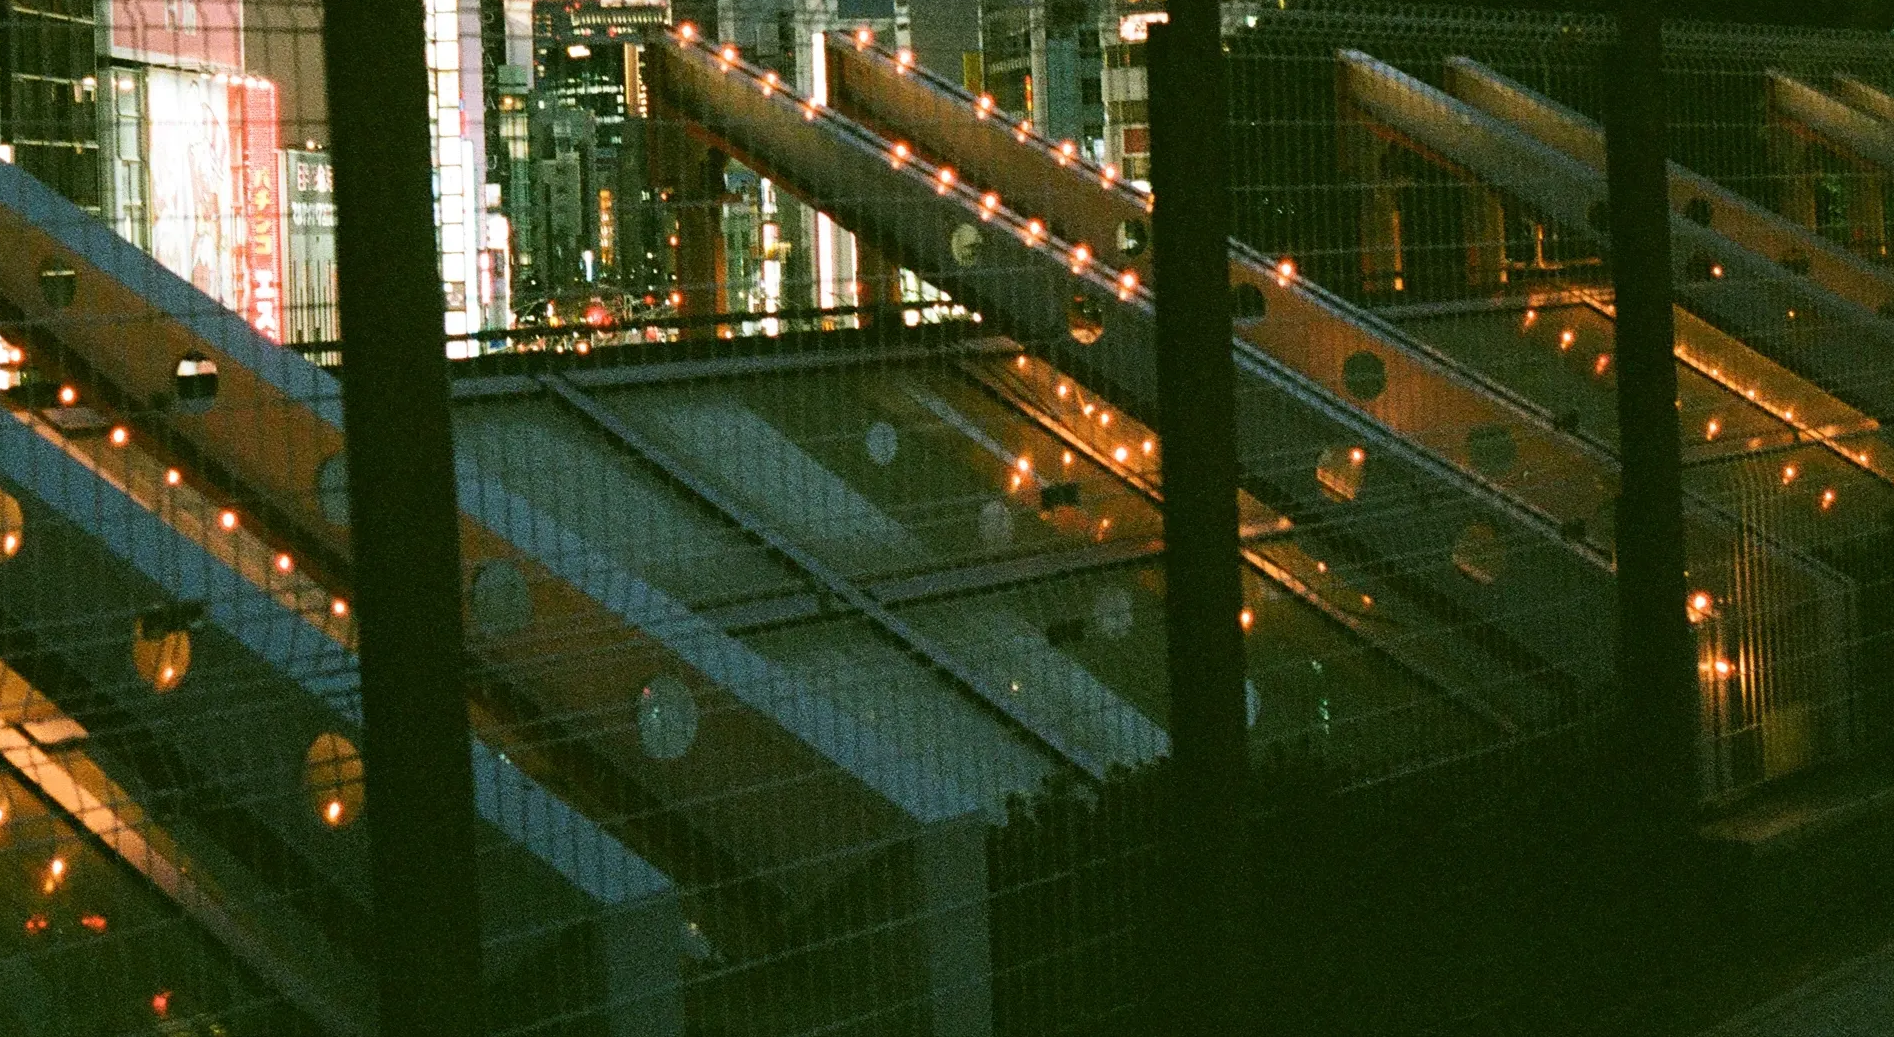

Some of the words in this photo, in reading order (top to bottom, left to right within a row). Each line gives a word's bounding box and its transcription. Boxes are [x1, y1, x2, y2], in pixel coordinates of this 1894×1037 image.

[255, 168, 272, 255] パチンコ
[256, 269, 276, 340] エス
